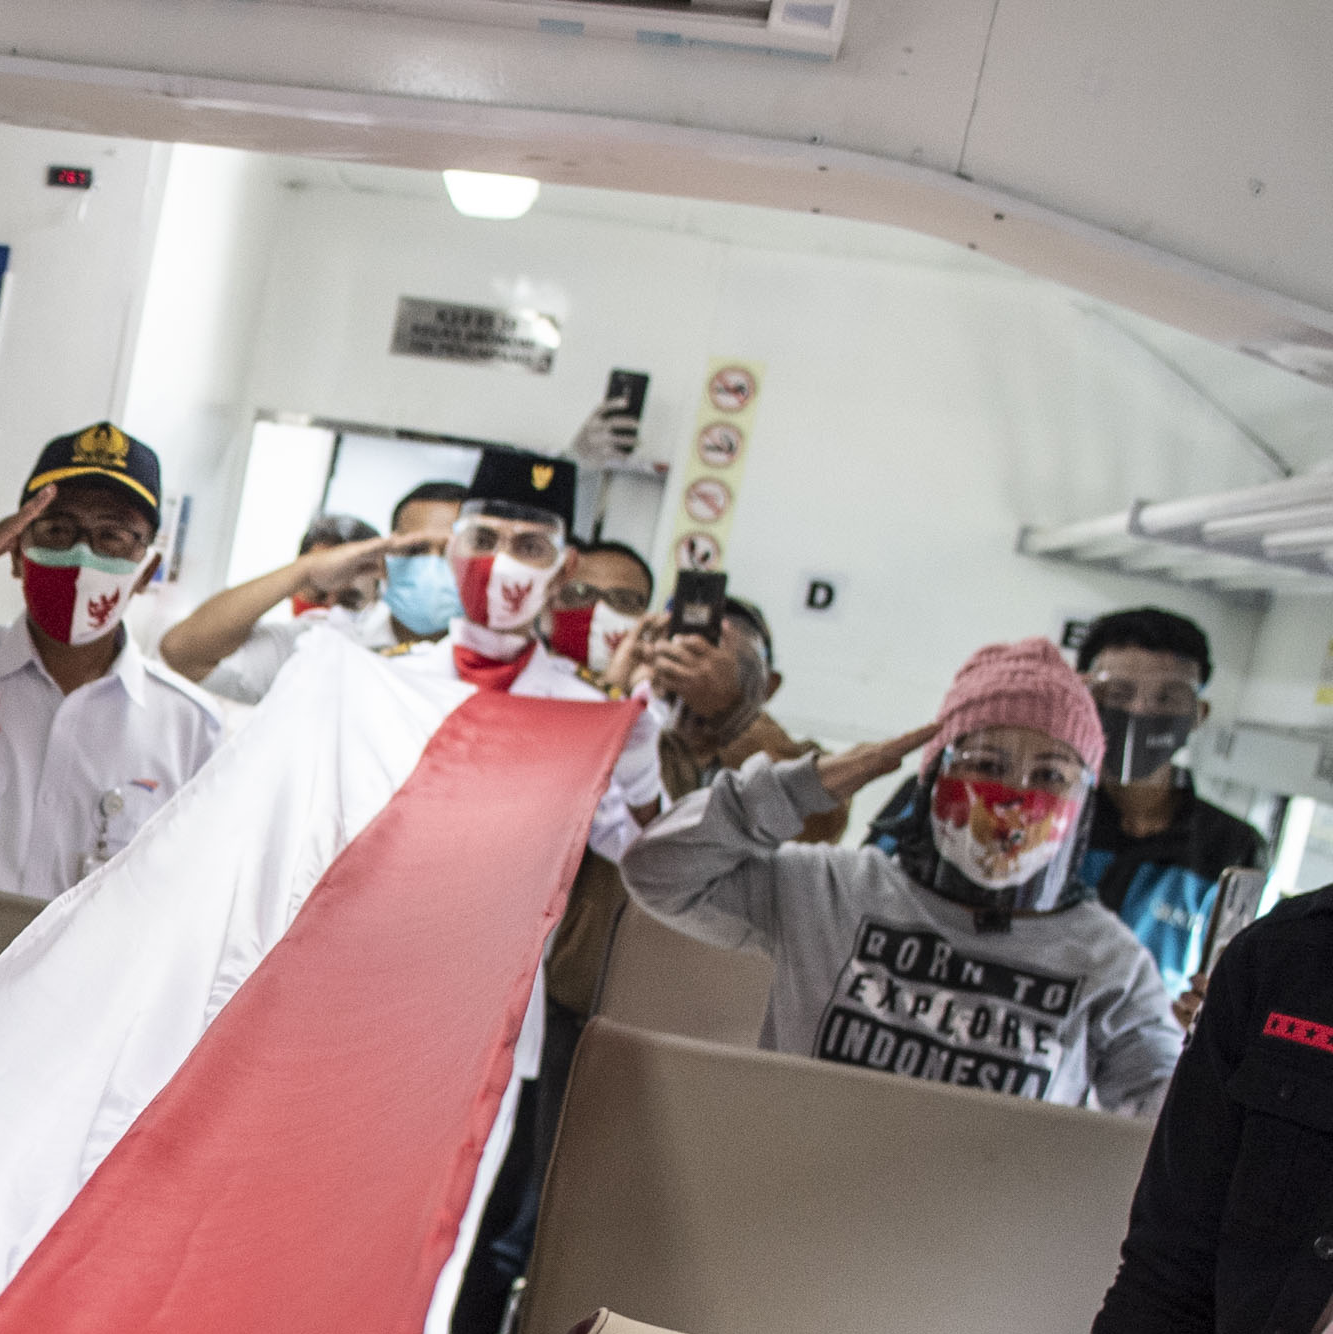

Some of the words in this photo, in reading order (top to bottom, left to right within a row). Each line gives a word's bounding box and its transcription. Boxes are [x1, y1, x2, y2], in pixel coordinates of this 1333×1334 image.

[806, 580, 835, 610] D
[864, 929, 986, 985] BORN
[1012, 974, 1067, 1010] TO
[848, 972, 1056, 1055] EXPLORE
[826, 1013, 1041, 1100] INDONESIA
